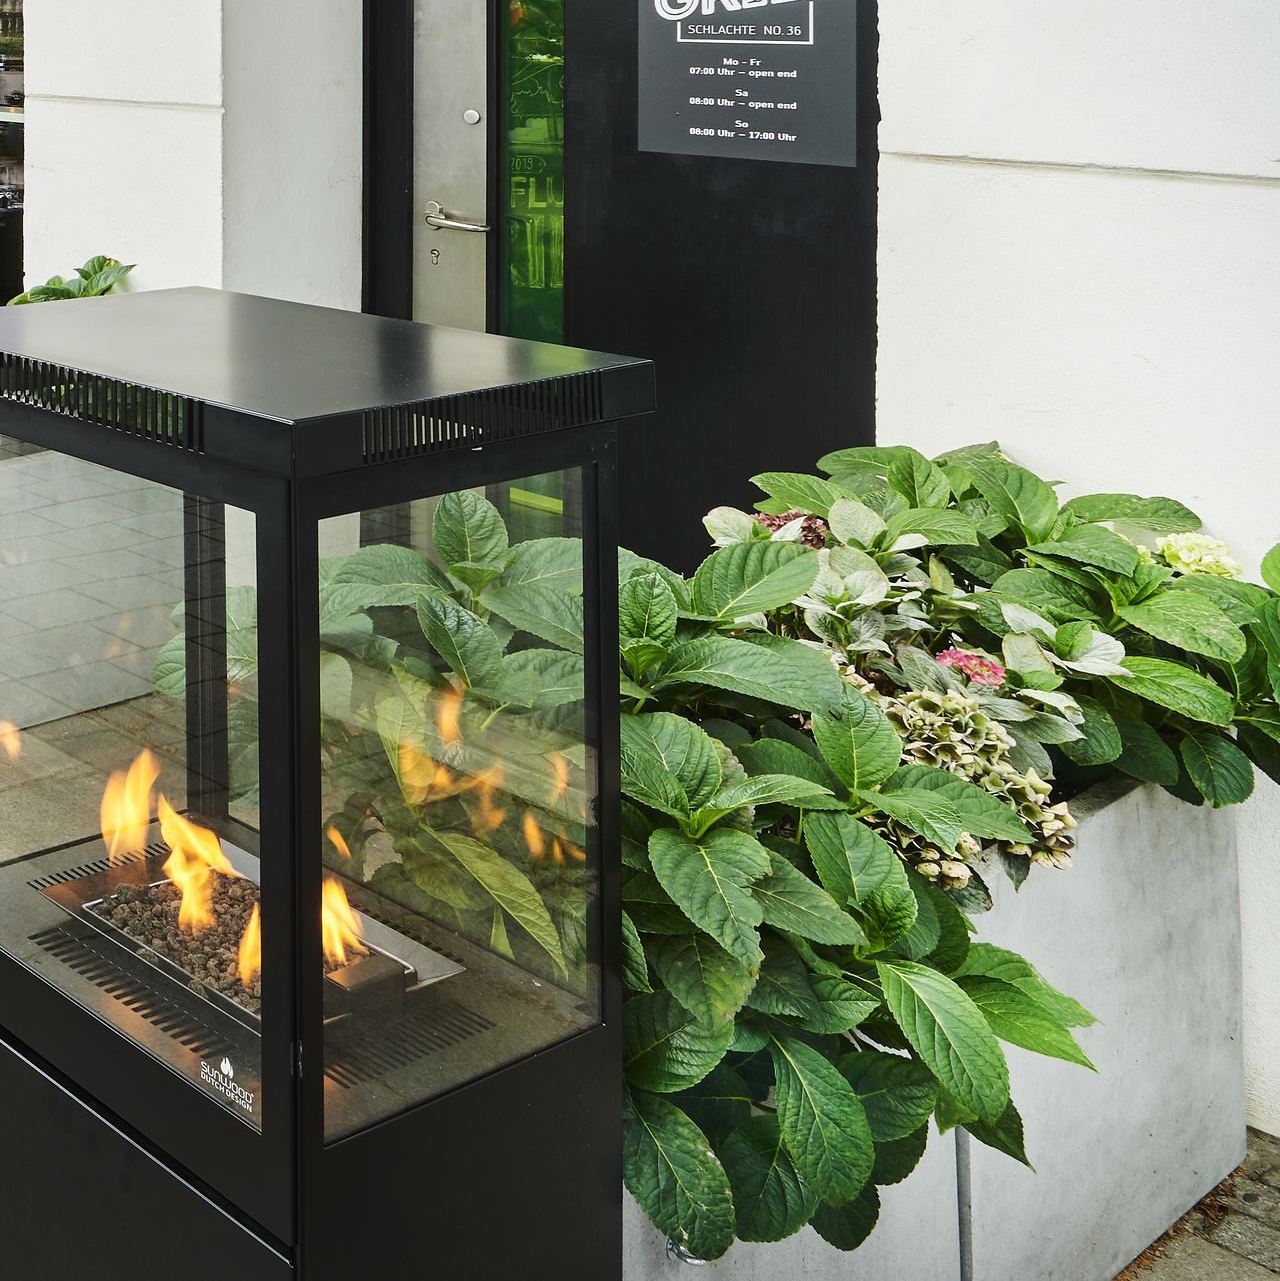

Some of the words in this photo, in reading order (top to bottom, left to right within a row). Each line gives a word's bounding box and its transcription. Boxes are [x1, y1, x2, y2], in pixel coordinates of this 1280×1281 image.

[688, 24, 756, 36] SCHLACHTE
[763, 25, 784, 36] NO.
[786, 25, 801, 36] 36
[723, 58, 739, 66] Mo
[749, 58, 761, 67] Fr
[689, 67, 715, 76] 07:00
[717, 68, 735, 77] Uhr
[748, 69, 774, 79] open
[777, 70, 797, 78] end
[735, 89, 749, 97] Sa
[689, 98, 715, 107] 08:00
[717, 98, 735, 107] Uhr
[748, 100, 774, 110] open
[777, 101, 797, 110] end
[735, 120, 749, 128] So
[689, 127, 715, 137] 08:00
[717, 129, 735, 138] Uhr
[748, 131, 775, 141] 17:00
[777, 132, 797, 142] Uhr
[200, 1072, 225, 1094] DUTCH
[225, 1088, 253, 1113] DESIGN
